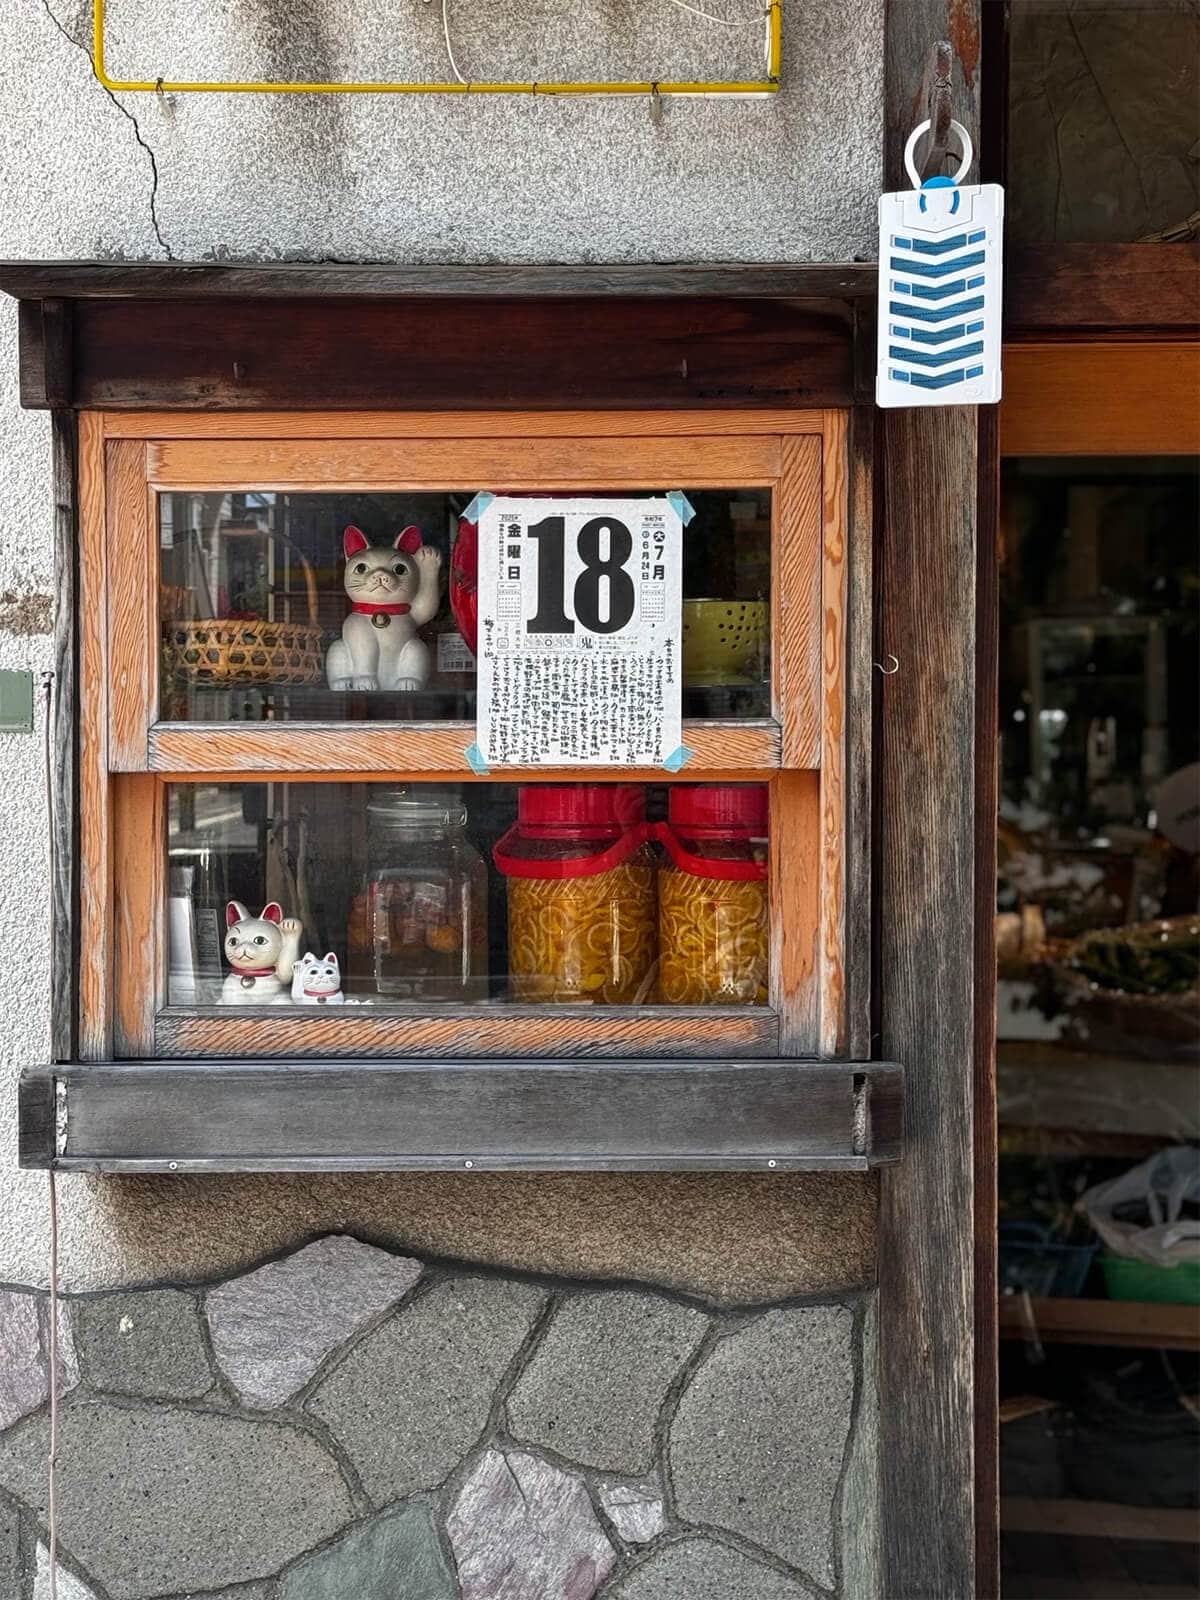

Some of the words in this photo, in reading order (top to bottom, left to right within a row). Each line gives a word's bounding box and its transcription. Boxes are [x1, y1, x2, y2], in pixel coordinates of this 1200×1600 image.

[507, 523, 521, 580] 金曜日
[527, 516, 635, 634] 18
